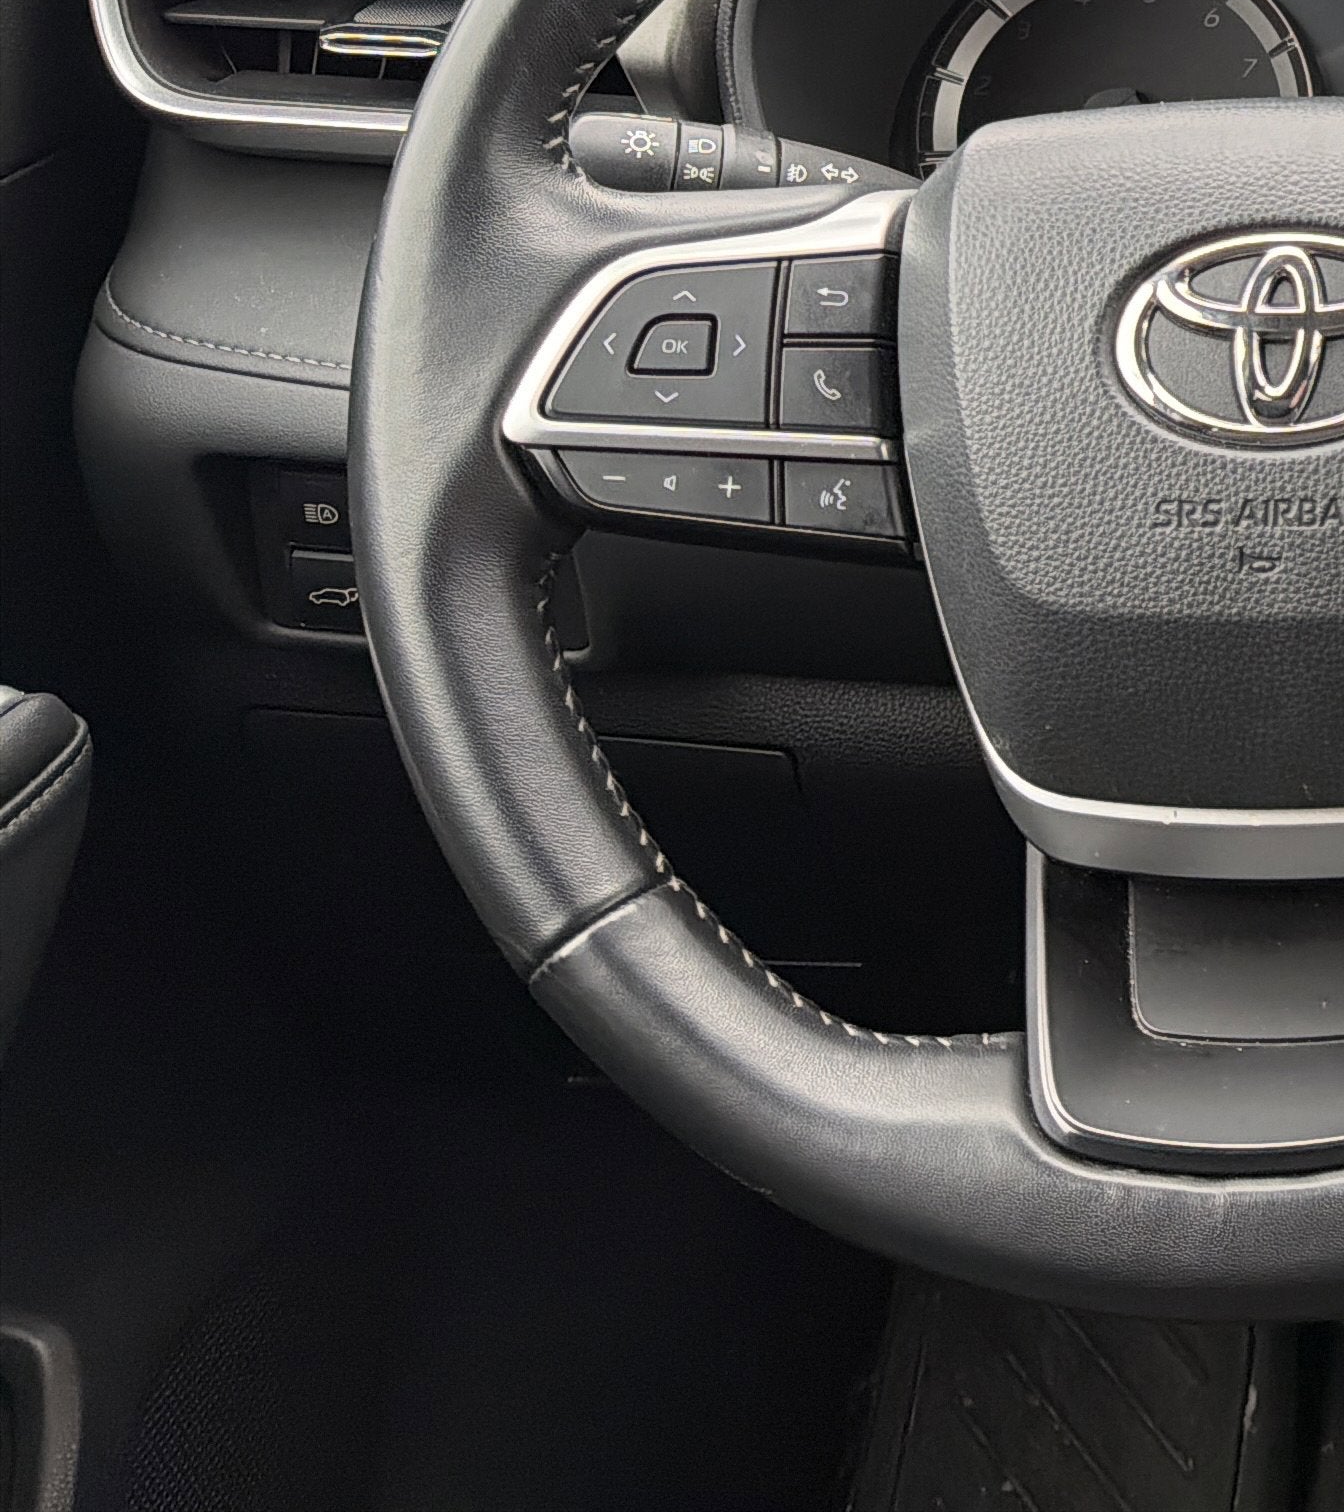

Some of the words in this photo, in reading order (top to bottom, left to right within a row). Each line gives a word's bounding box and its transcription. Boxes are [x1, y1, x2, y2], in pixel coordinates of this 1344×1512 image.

[1203, 8, 1220, 28] 6
[1241, 58, 1258, 78] 7
[661, 339, 689, 354] OK
[1153, 499, 1223, 529] SRS
